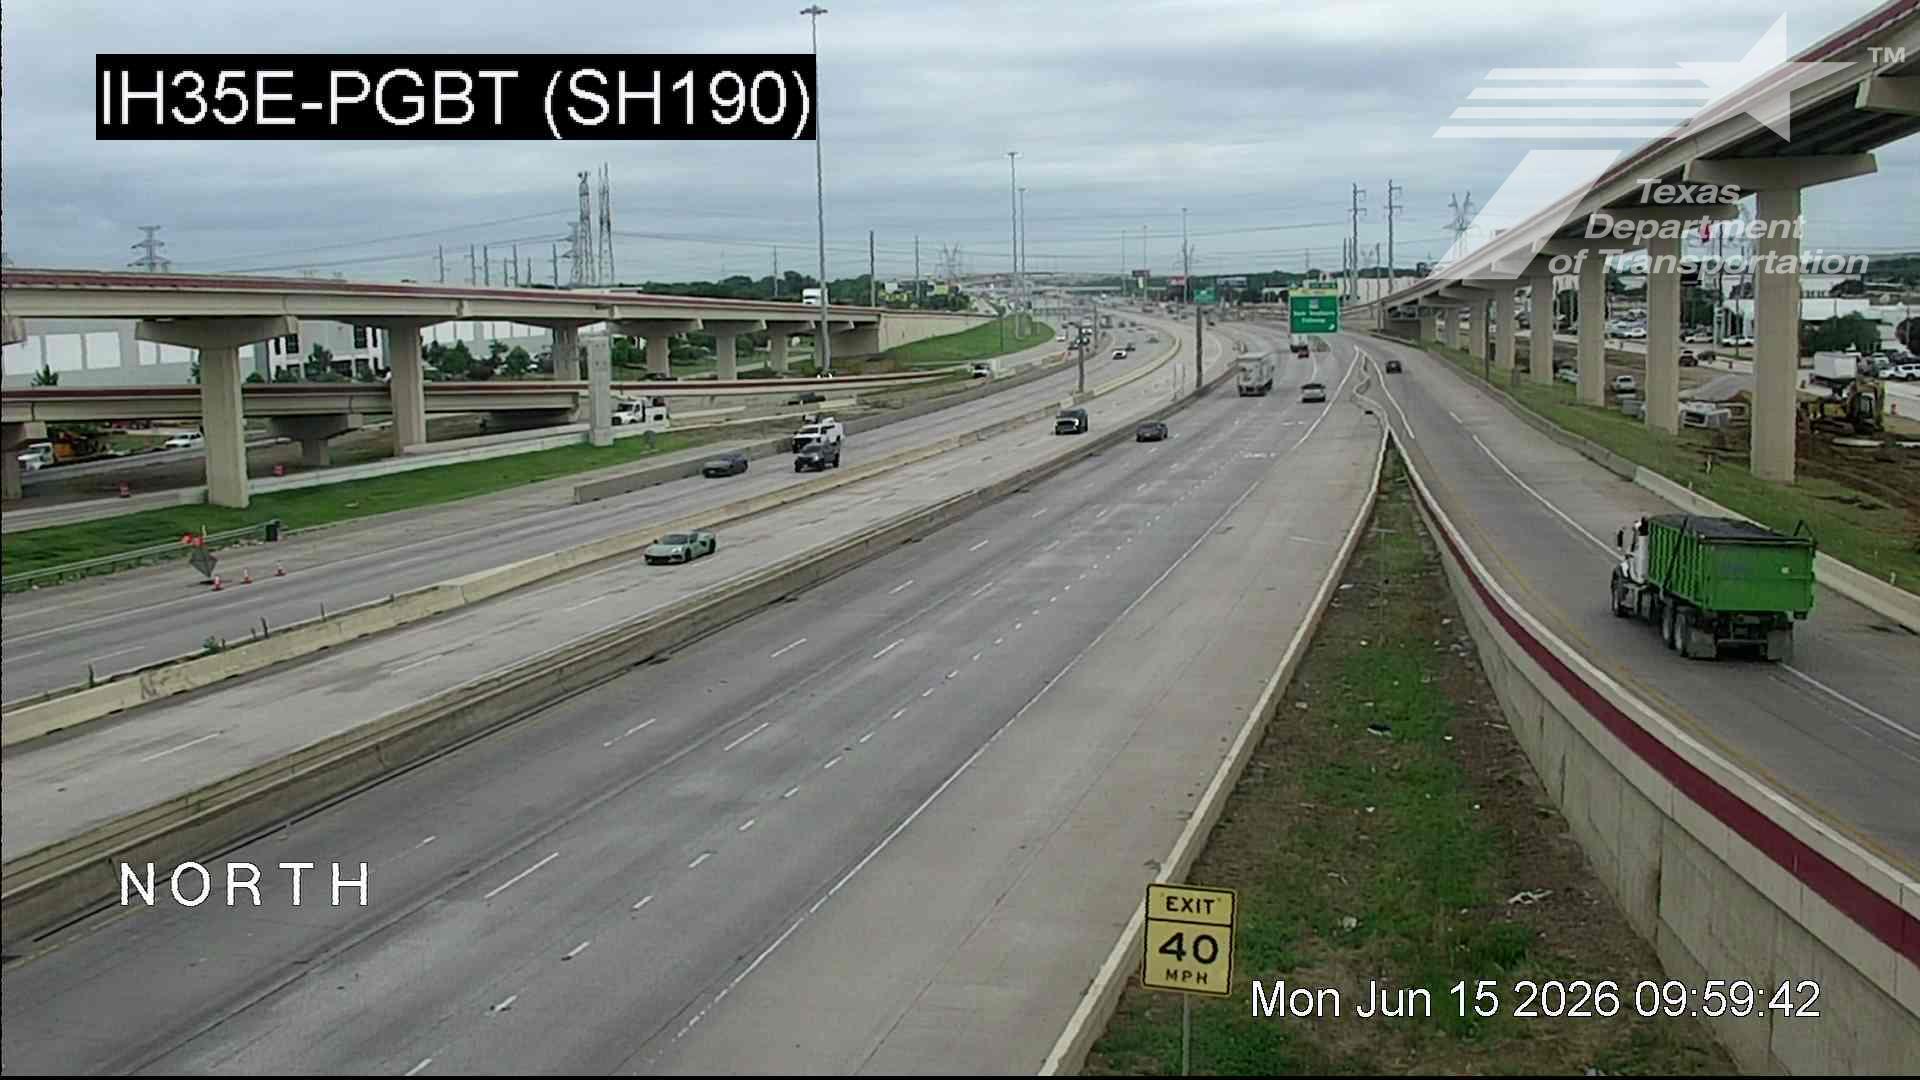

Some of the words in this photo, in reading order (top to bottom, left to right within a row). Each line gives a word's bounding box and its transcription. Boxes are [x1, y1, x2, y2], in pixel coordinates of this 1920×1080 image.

[1166, 895, 1215, 914] EXIT
[1158, 932, 1218, 964] 40
[1165, 968, 1208, 985] MPH
